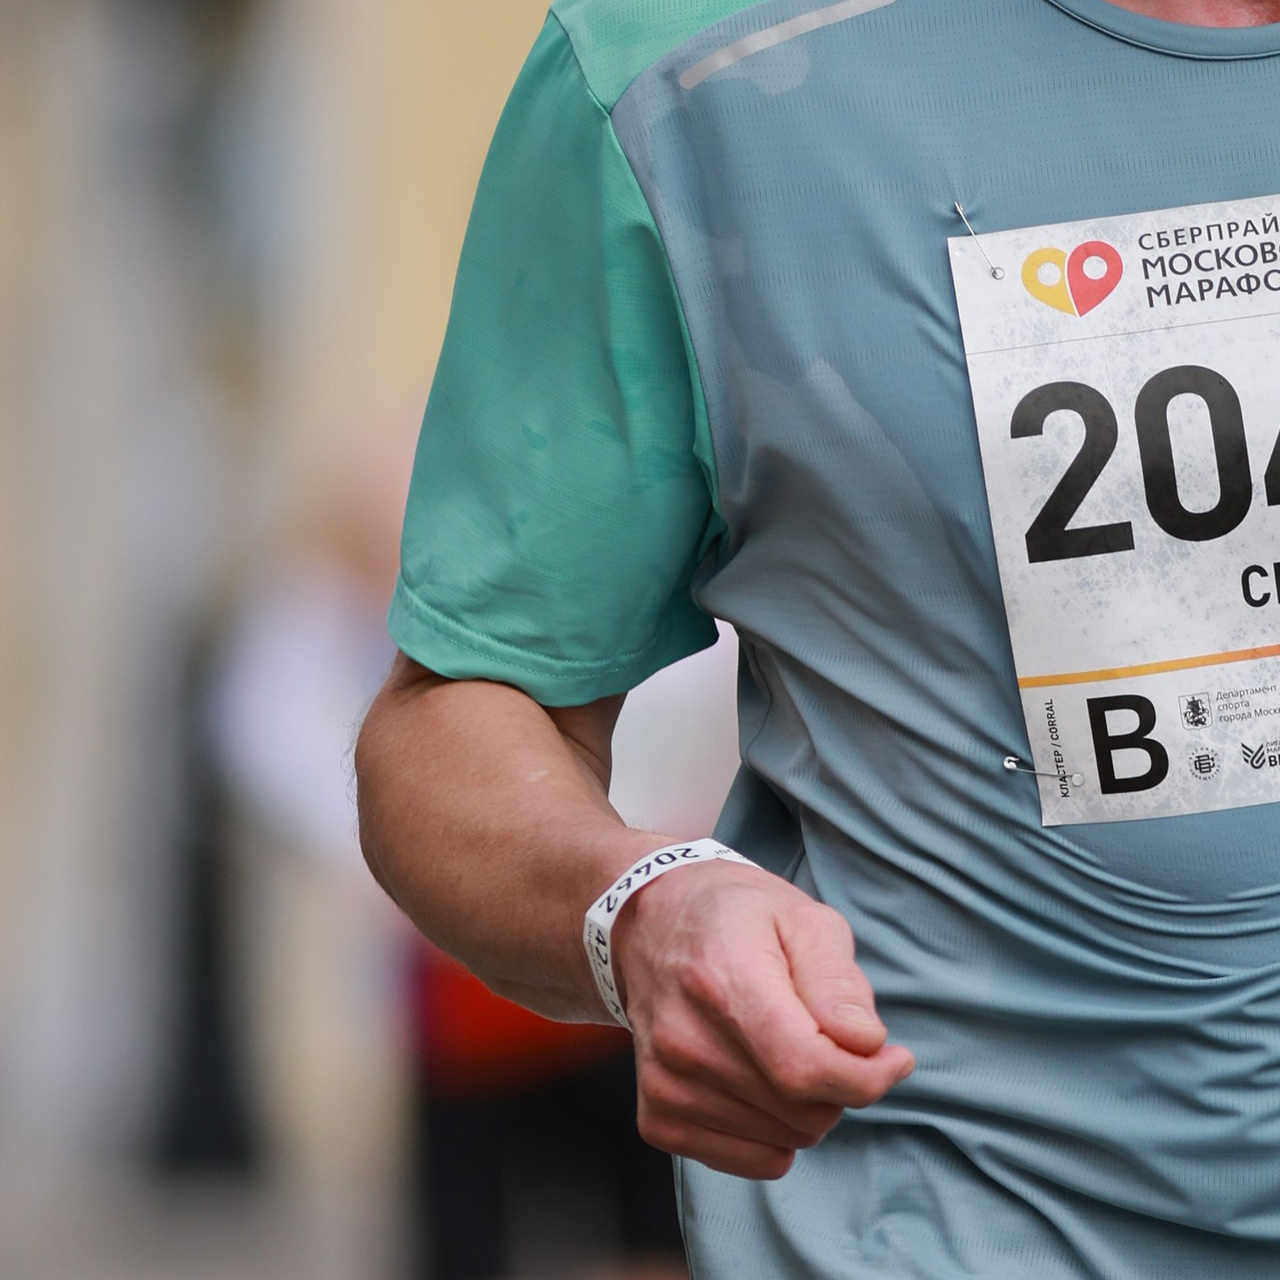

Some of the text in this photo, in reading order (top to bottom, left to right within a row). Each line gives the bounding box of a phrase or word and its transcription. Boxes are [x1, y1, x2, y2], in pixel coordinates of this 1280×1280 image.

[1216, 685, 1277, 701] Департамент
[1218, 701, 1250, 711] спорта
[1050, 698, 1060, 741] CORRAL
[1220, 711, 1252, 723] города
[1054, 750, 1069, 797] КЛАСТЕР
[598, 847, 700, 914] 20462
